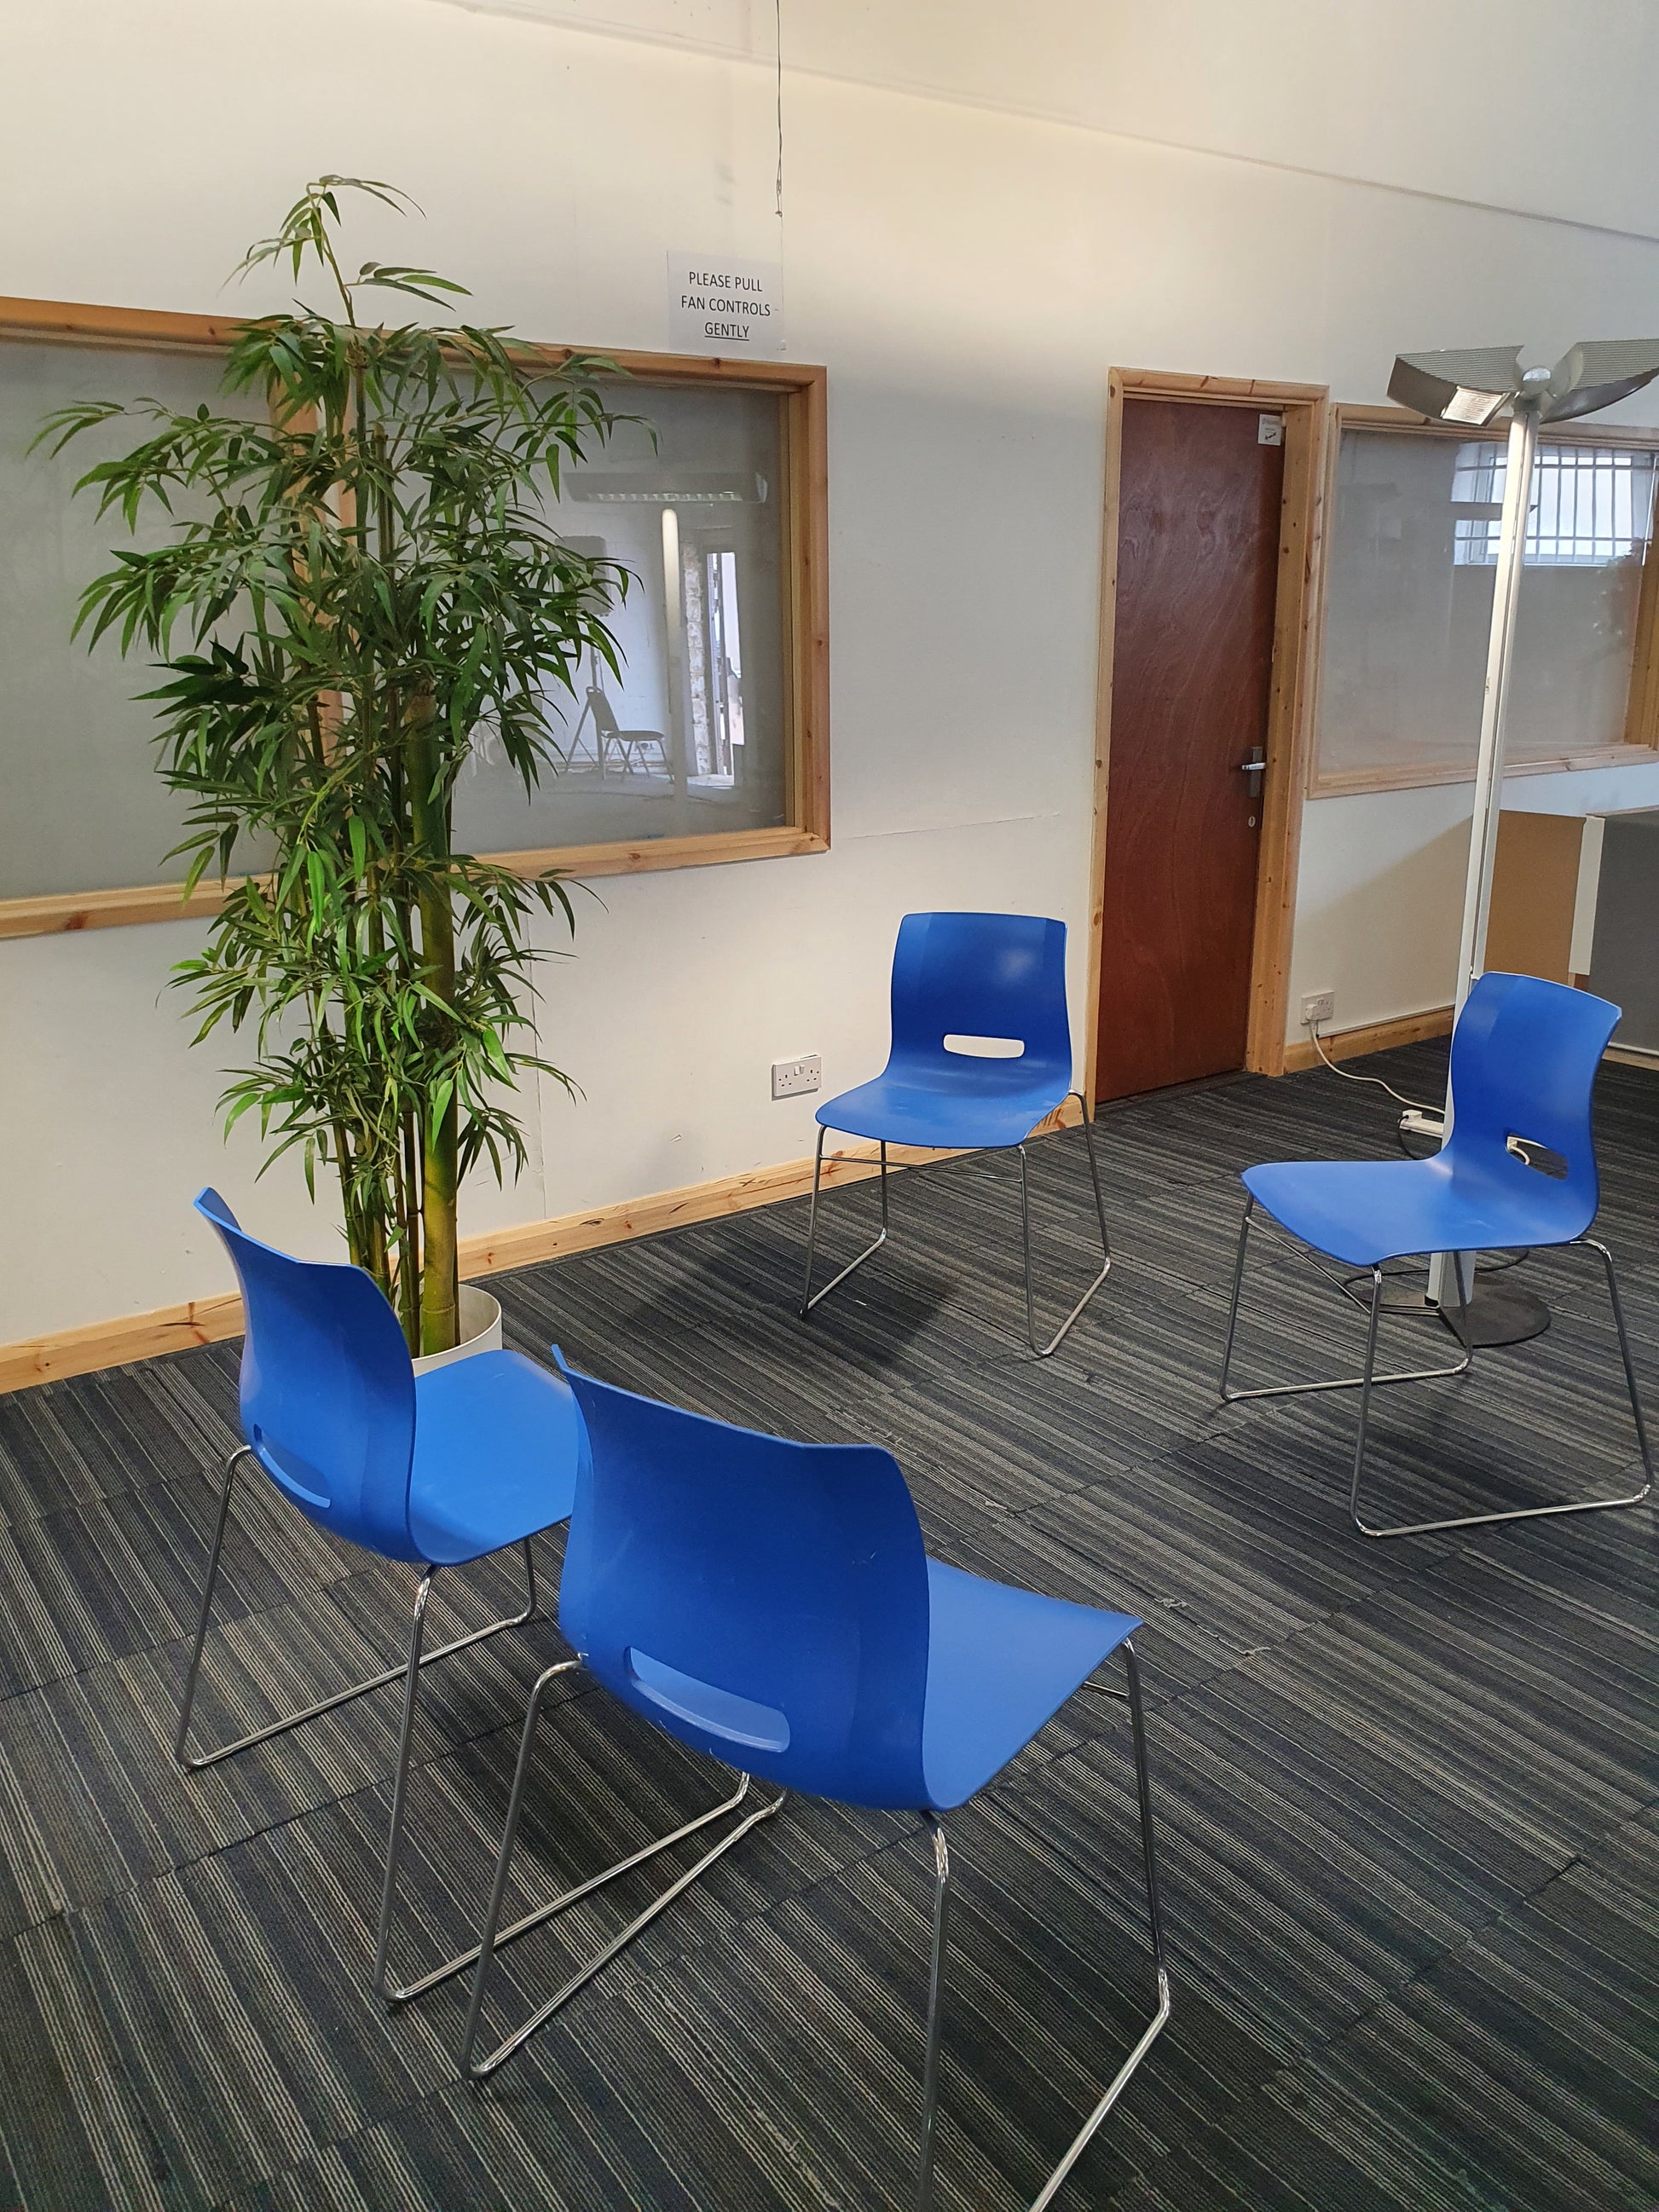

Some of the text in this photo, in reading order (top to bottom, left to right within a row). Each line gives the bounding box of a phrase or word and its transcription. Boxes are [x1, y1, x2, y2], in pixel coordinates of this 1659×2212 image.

[689, 271, 763, 292] PLEASE PULL
[681, 295, 771, 316] FAN CONTROLS
[704, 321, 749, 338] GENTLY
